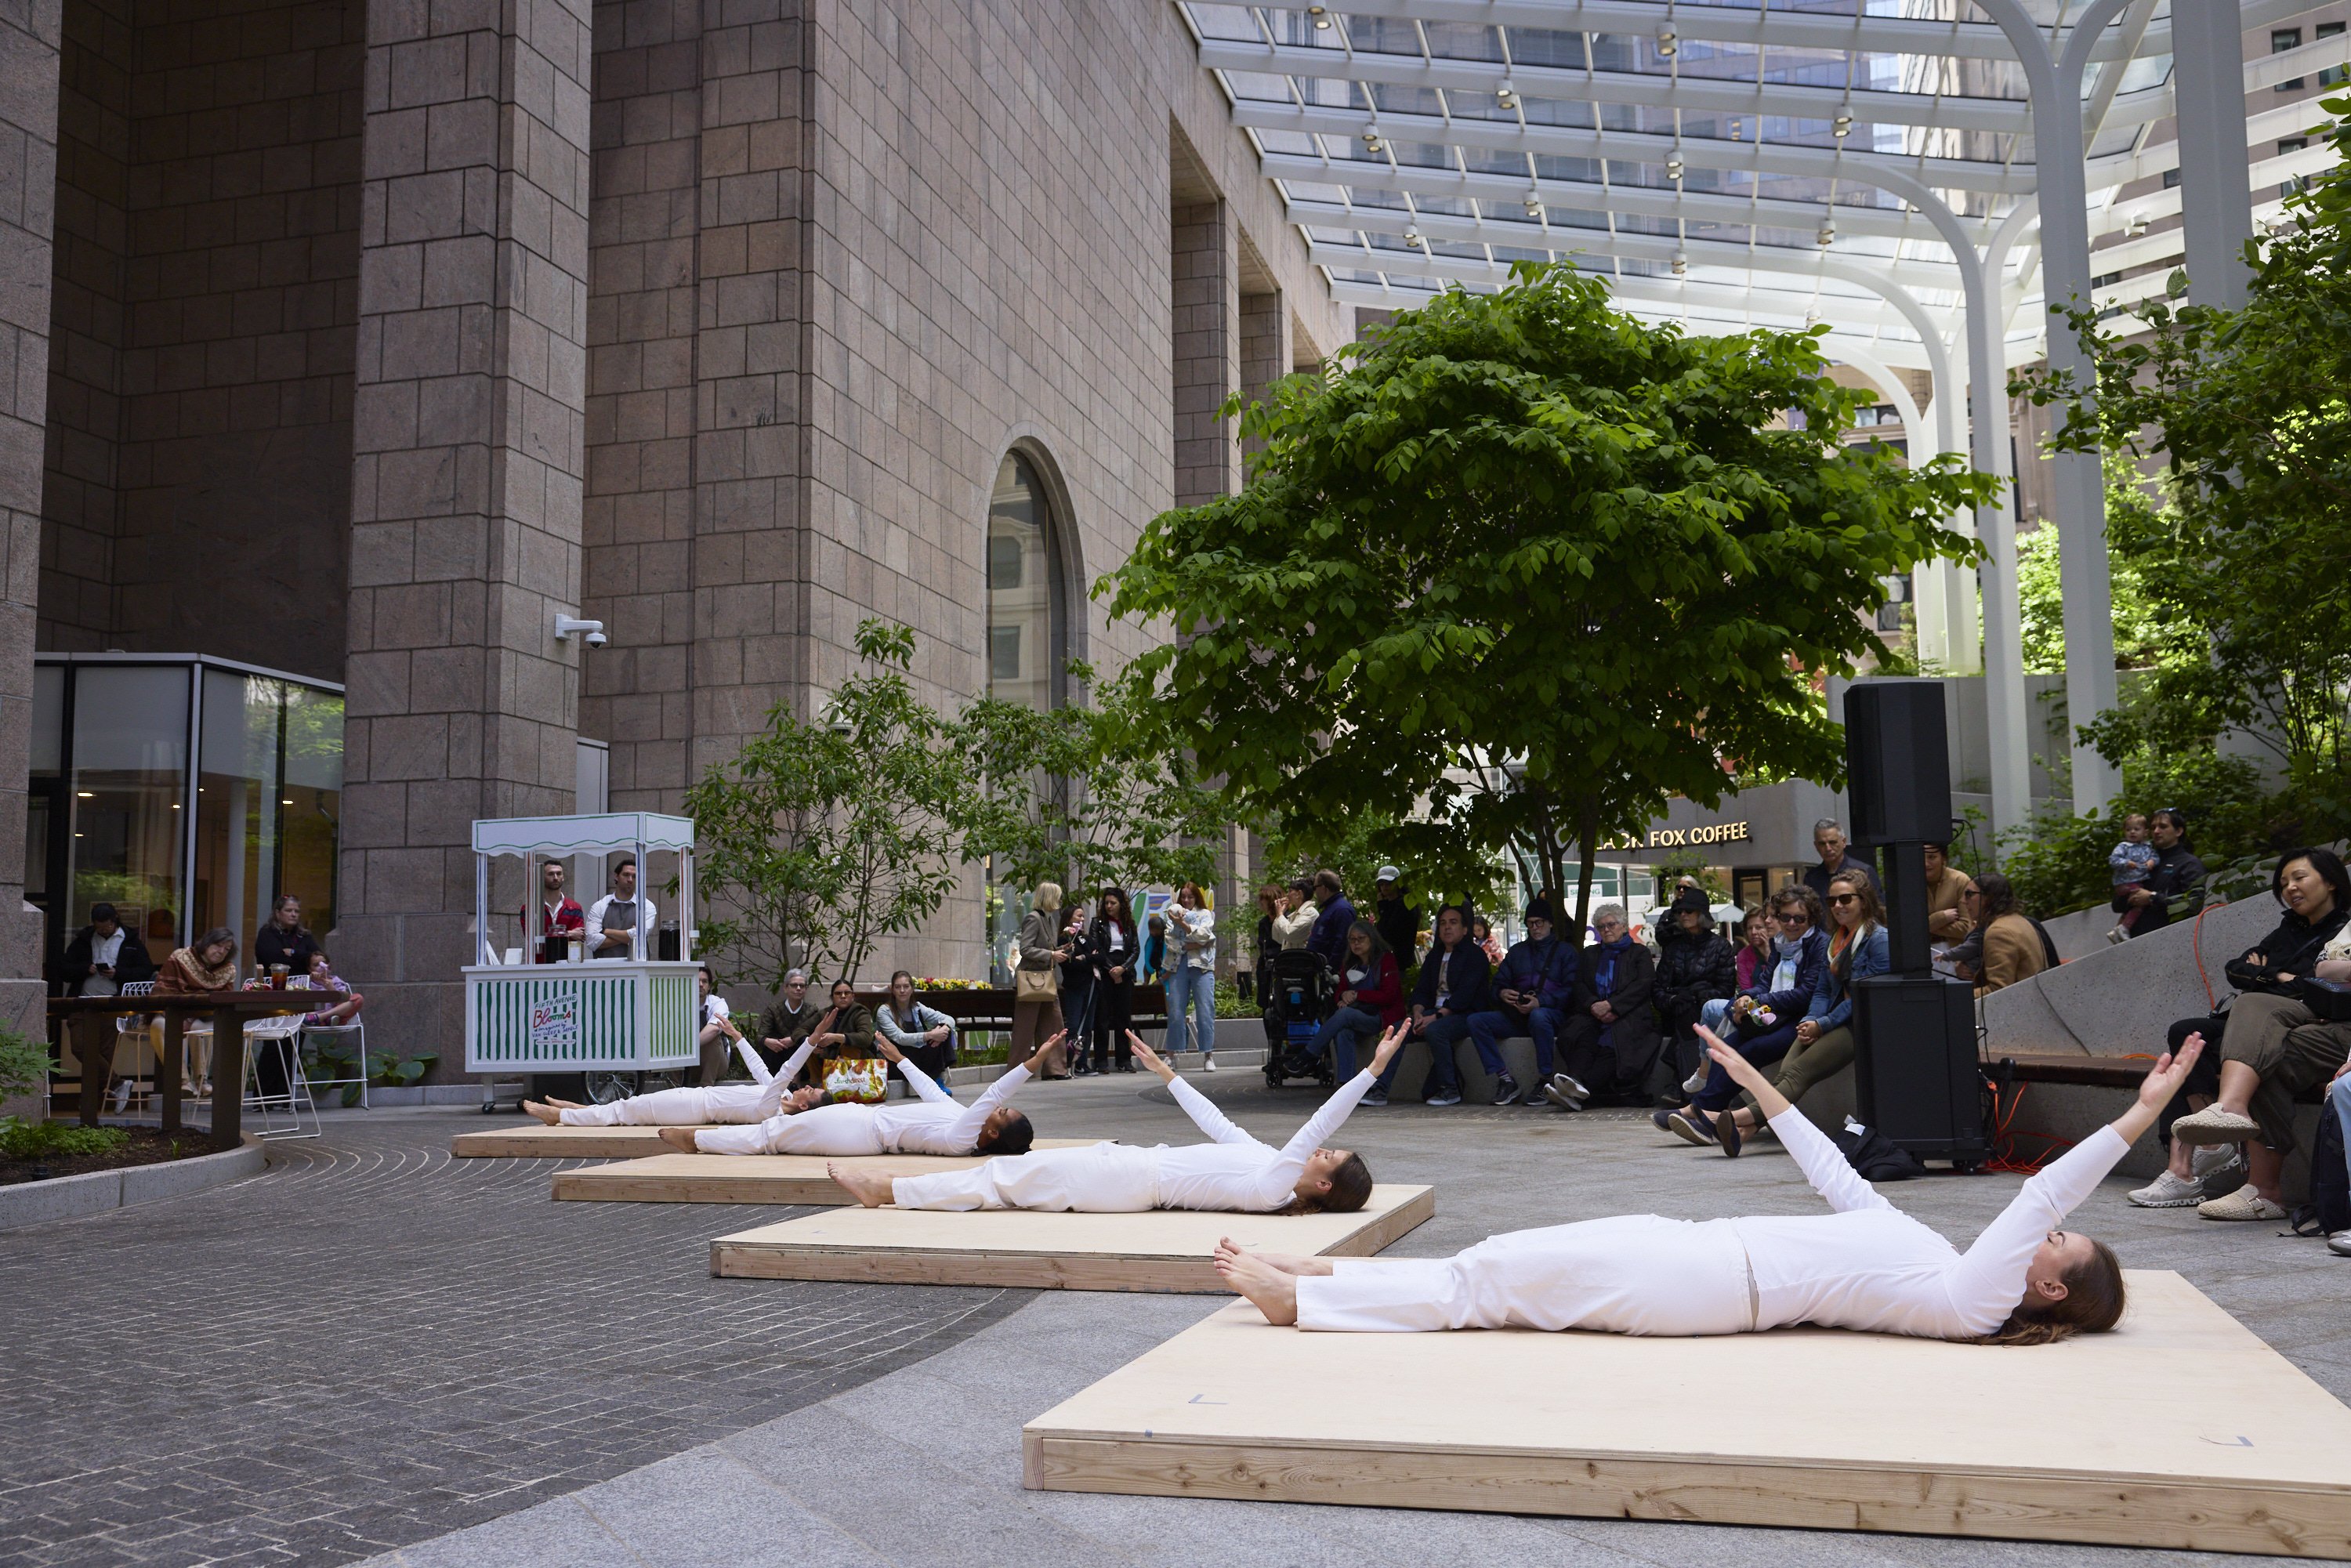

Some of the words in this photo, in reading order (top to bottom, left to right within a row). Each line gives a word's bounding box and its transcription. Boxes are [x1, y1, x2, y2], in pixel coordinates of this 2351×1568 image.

[1650, 829, 1686, 847] FOX
[1690, 821, 1748, 844] COFFEE
[554, 994, 577, 1005] AVENUE
[533, 1007, 571, 1029] Blooms
